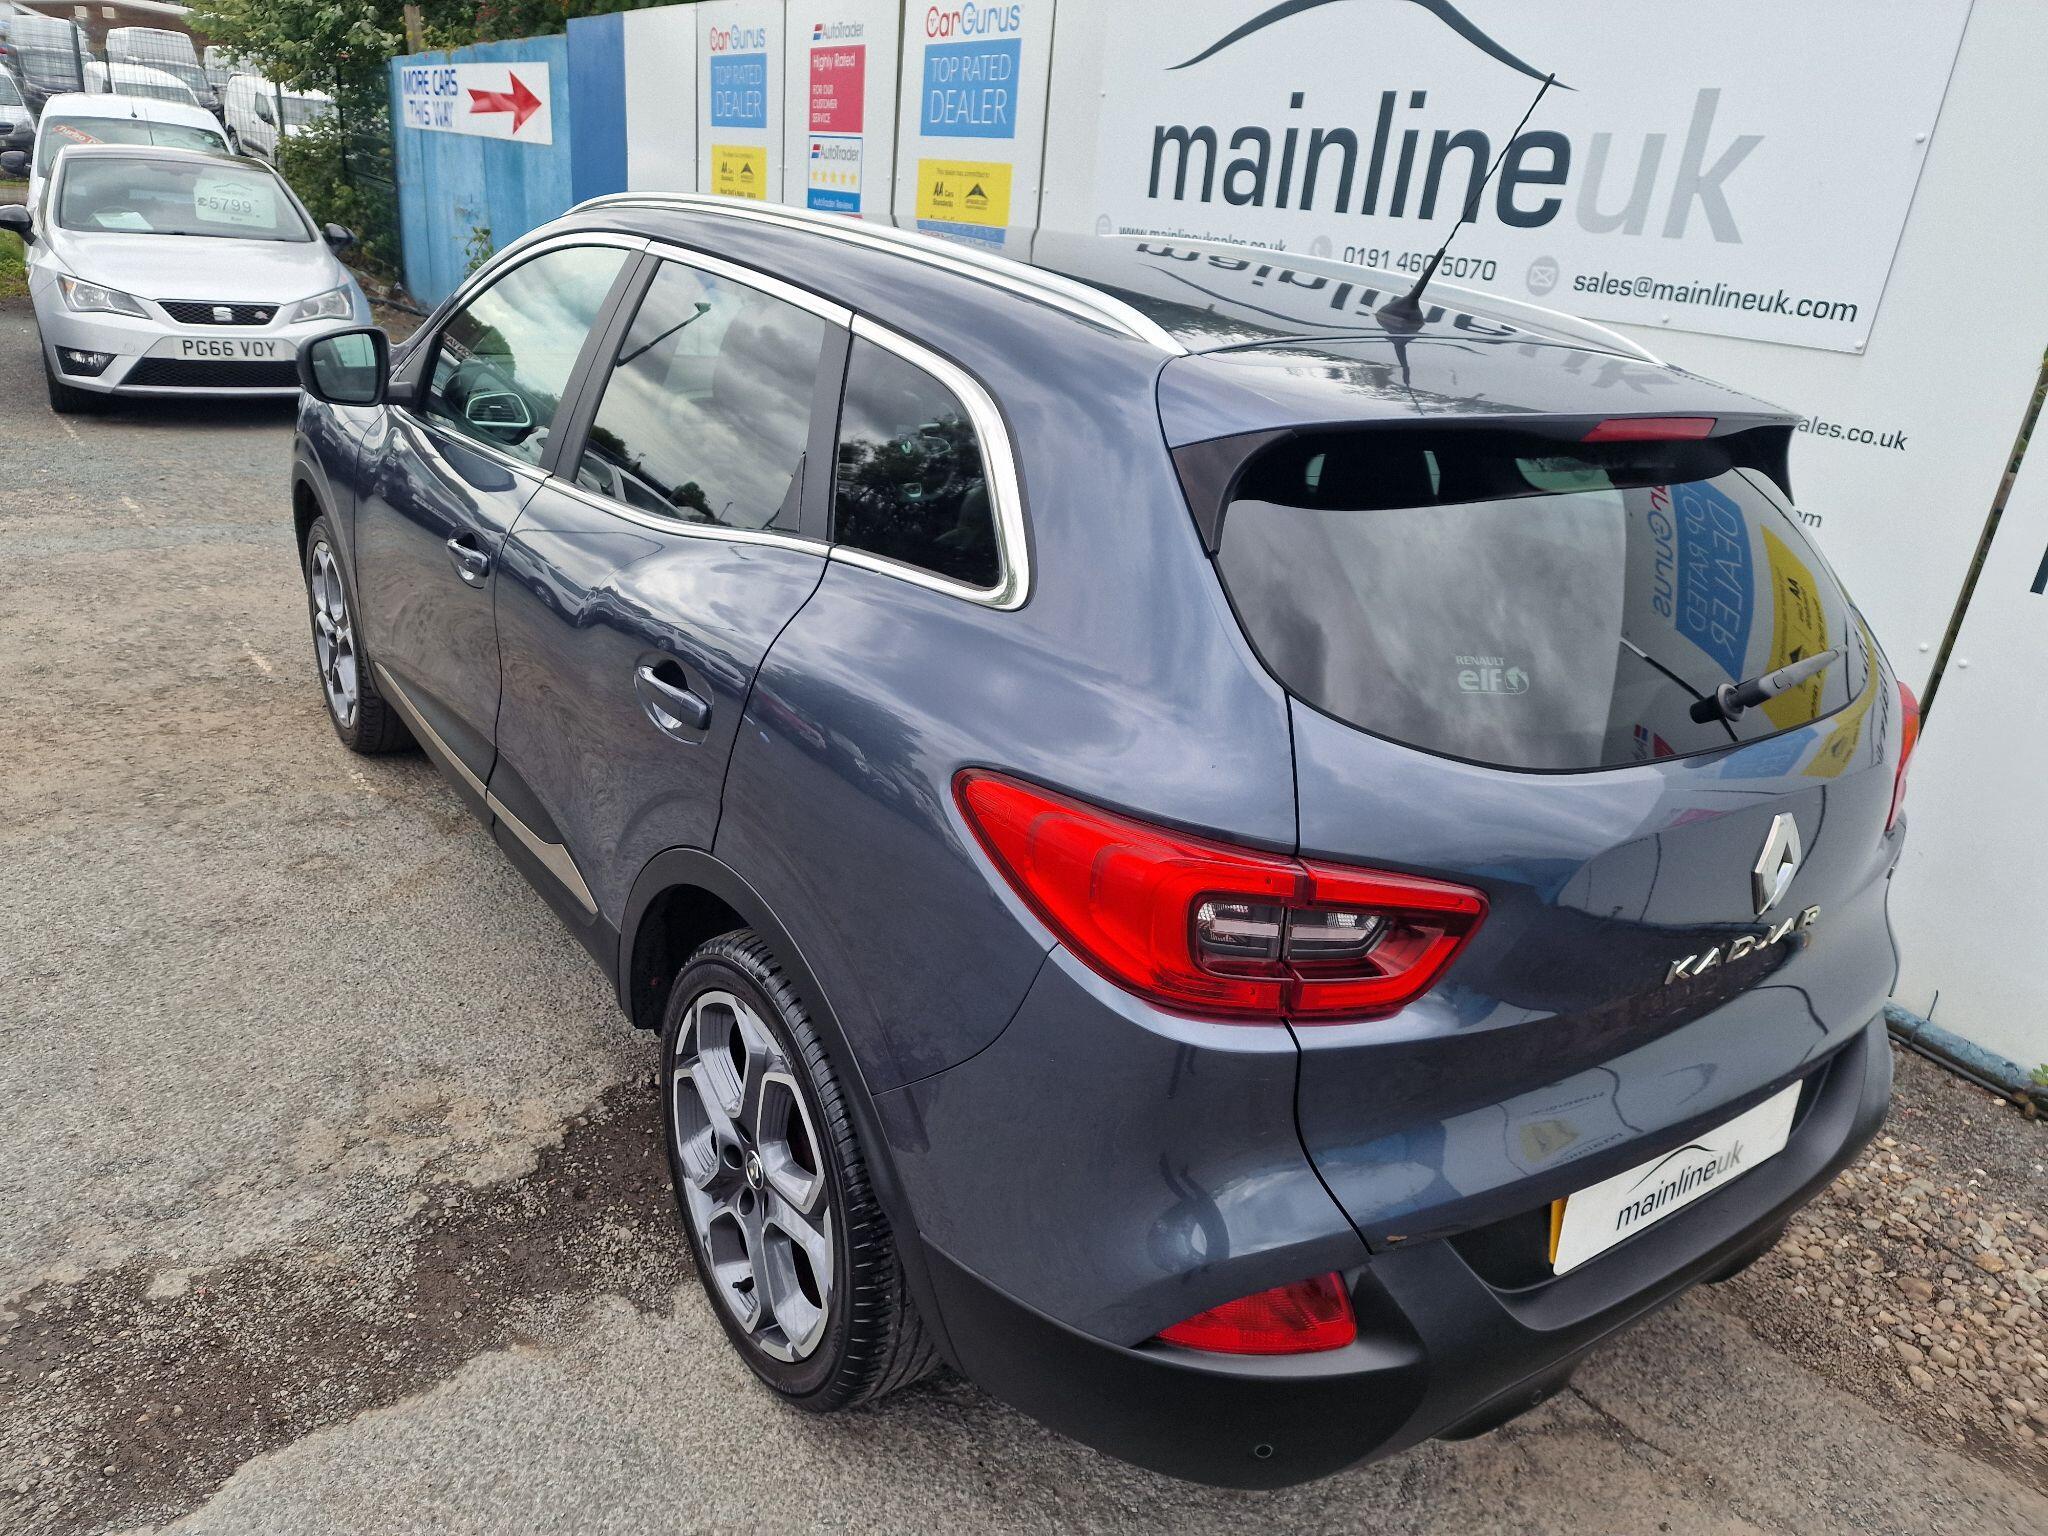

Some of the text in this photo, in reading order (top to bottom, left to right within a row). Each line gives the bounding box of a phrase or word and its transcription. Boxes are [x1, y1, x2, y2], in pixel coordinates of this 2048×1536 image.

[822, 21, 865, 40] AutoTrader
[926, 1, 1021, 38] CarGurus
[710, 23, 766, 52] CarGurus
[714, 63, 762, 86] TOP RATED
[813, 51, 856, 71] Highly Rated
[930, 53, 1012, 82] TOP RATED
[403, 68, 459, 97] MORE CARS
[408, 99, 454, 128] THIS WAY
[715, 89, 762, 118] DEALER
[929, 88, 1008, 125] DEALER
[820, 143, 860, 162] AutoTrader
[1147, 87, 1766, 245] mainlineuk
[932, 181, 944, 197] AA
[1343, 246, 1390, 270] 0191
[1441, 255, 1498, 282] 5070
[1572, 270, 1859, 323] sales@mainlineuk.com
[182, 339, 276, 357] PG66 VOY
[1455, 655, 1506, 666] RENAULT
[1458, 668, 1502, 692] elf
[1664, 904, 1822, 985] KADJAR
[1615, 1139, 1745, 1232] mainlineuk
